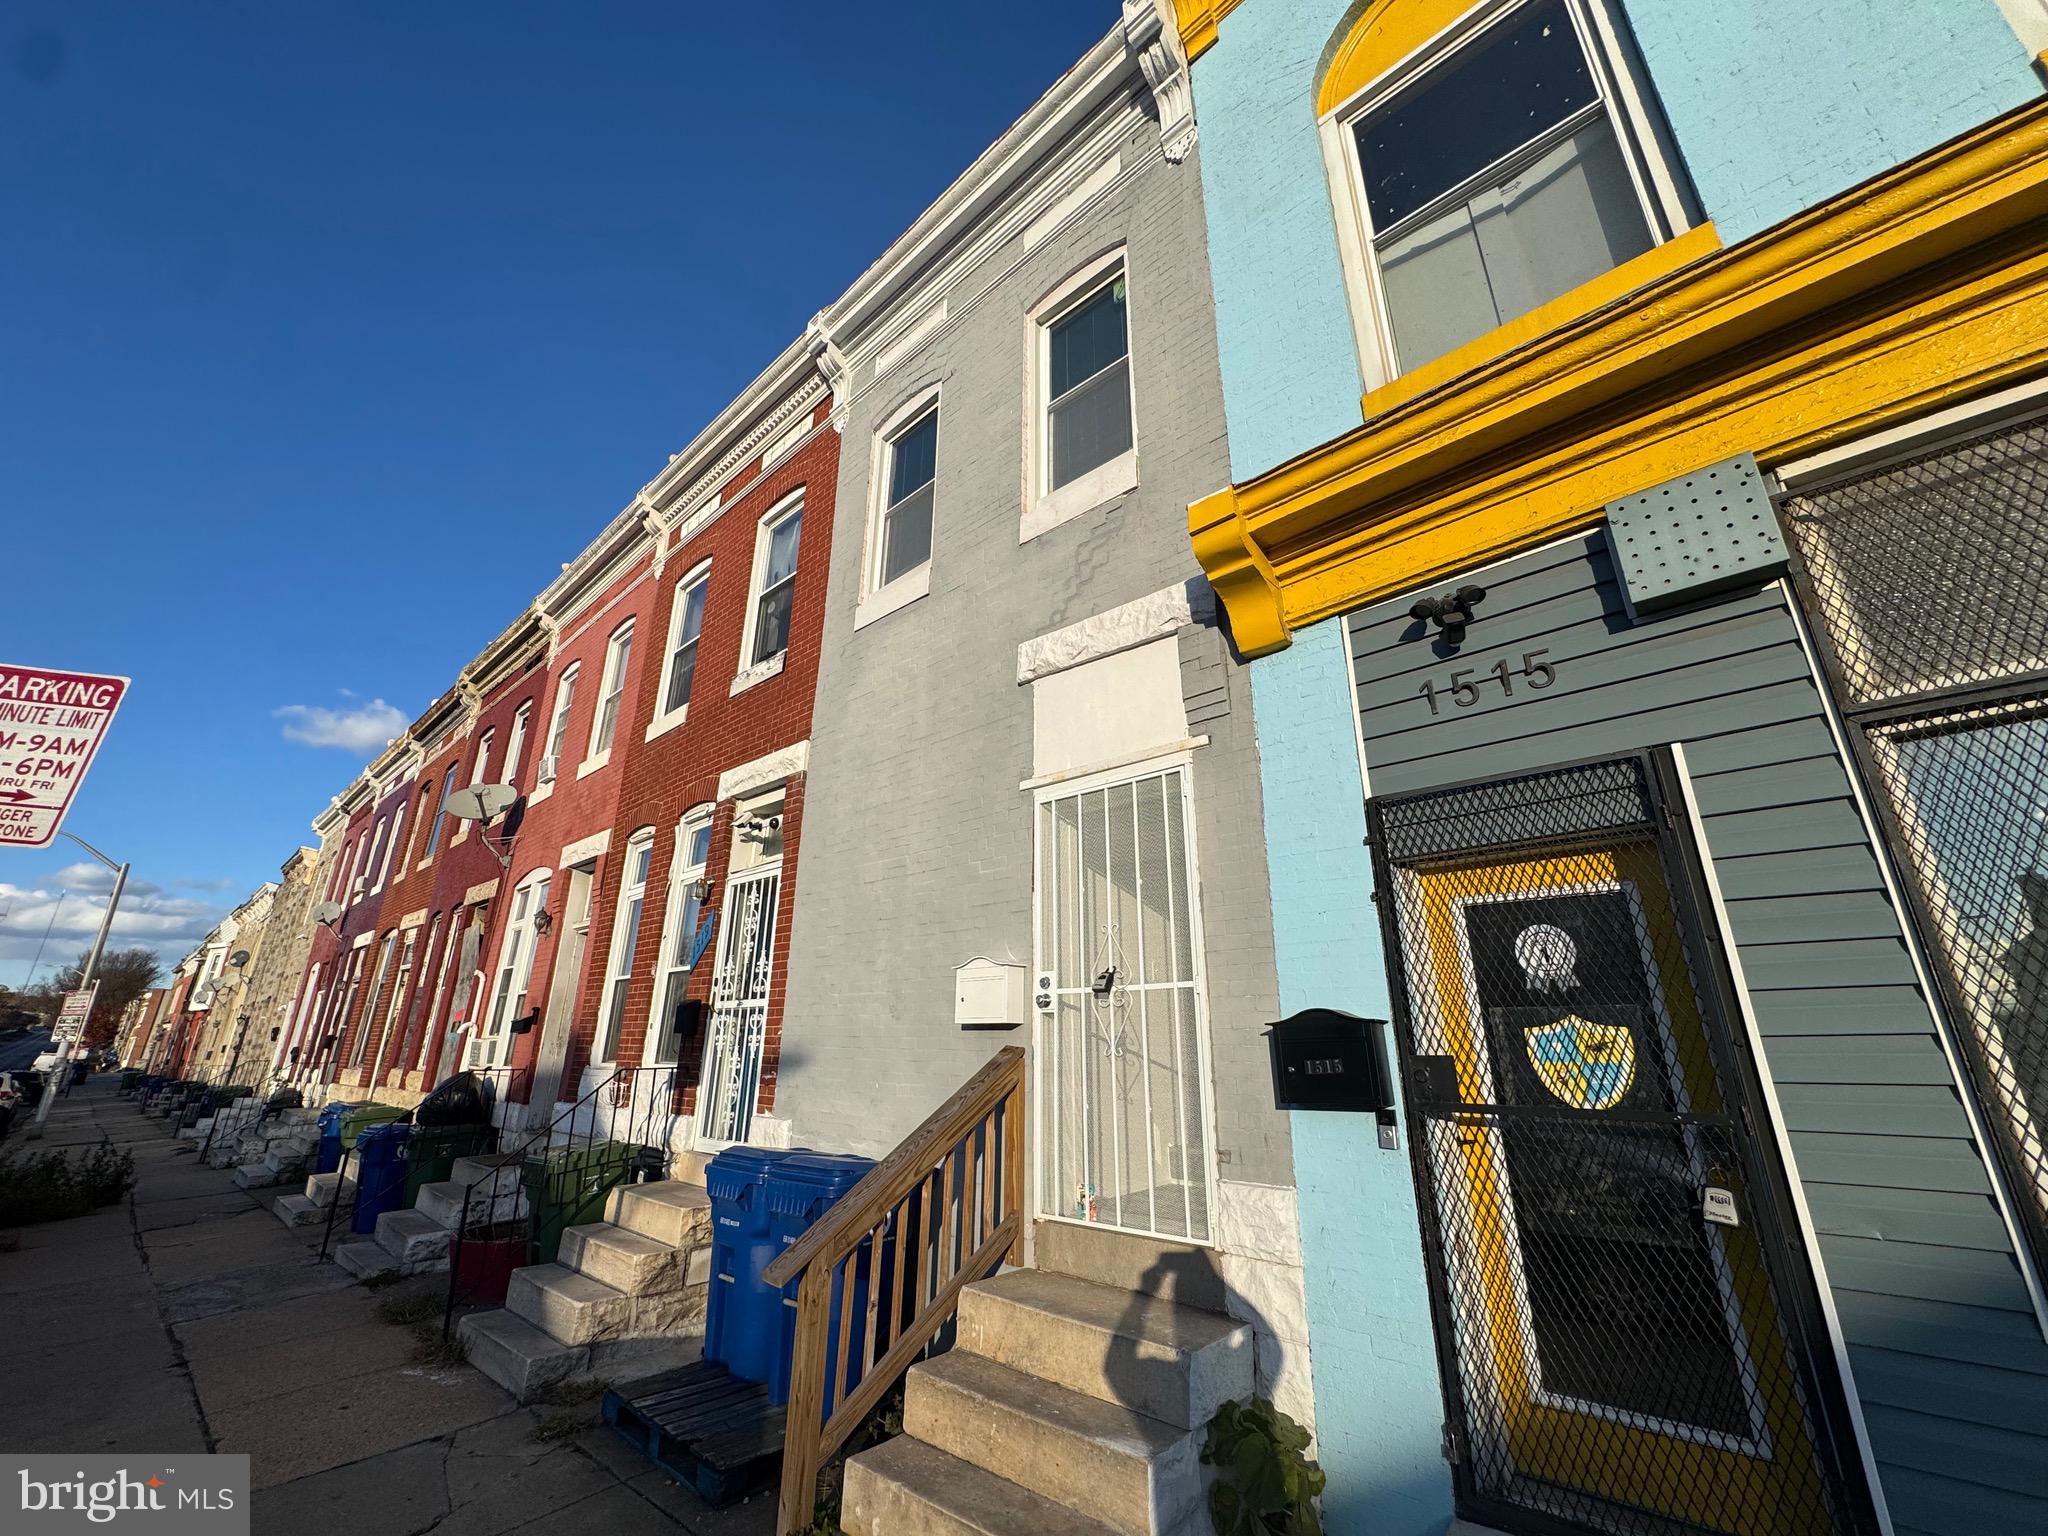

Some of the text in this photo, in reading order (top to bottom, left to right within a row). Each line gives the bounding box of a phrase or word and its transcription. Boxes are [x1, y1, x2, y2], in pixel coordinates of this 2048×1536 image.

[1418, 648, 1556, 715] 1515
[56, 708, 104, 730] LIMIT
[30, 780, 55, 790] FRI
[0, 808, 33, 822] GER
[1305, 1058, 1342, 1074] 1515
